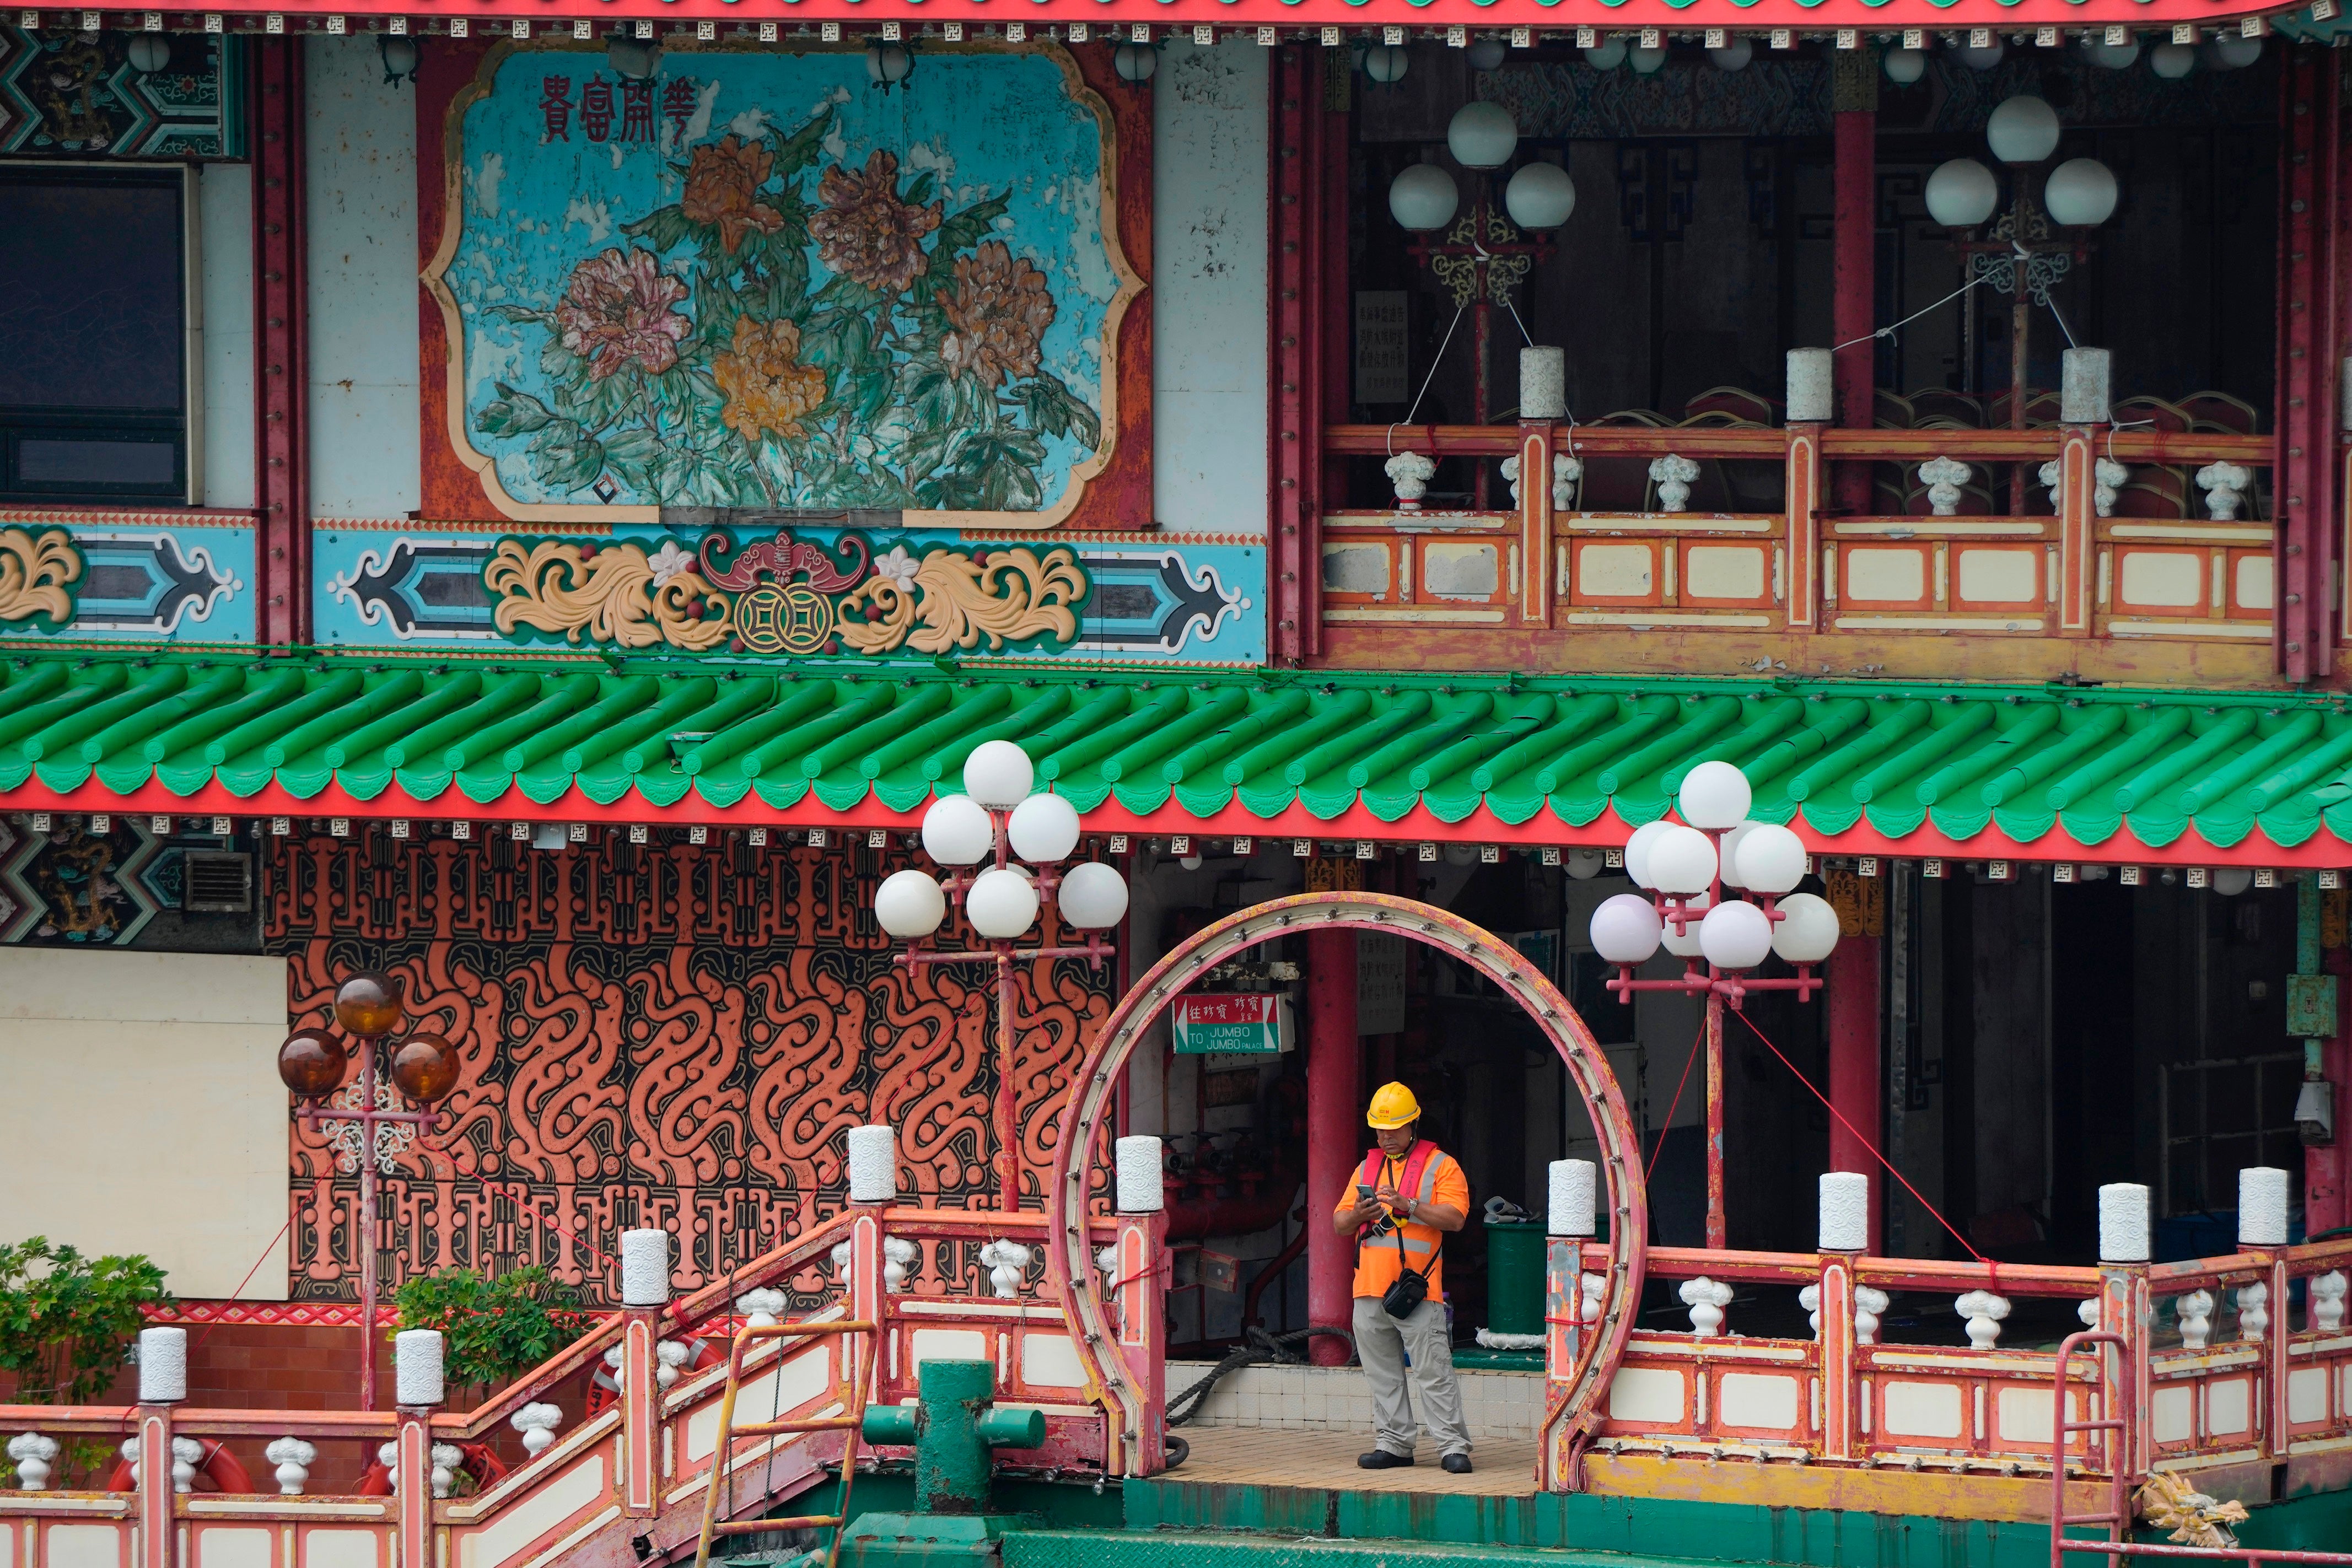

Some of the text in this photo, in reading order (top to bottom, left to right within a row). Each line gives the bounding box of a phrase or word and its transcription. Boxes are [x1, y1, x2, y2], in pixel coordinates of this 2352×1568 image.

[1234, 995, 1259, 1012] 珍寶
[1189, 1027, 1250, 1044] TO JUMBO
[1207, 1039, 1241, 1050] JUMBO
